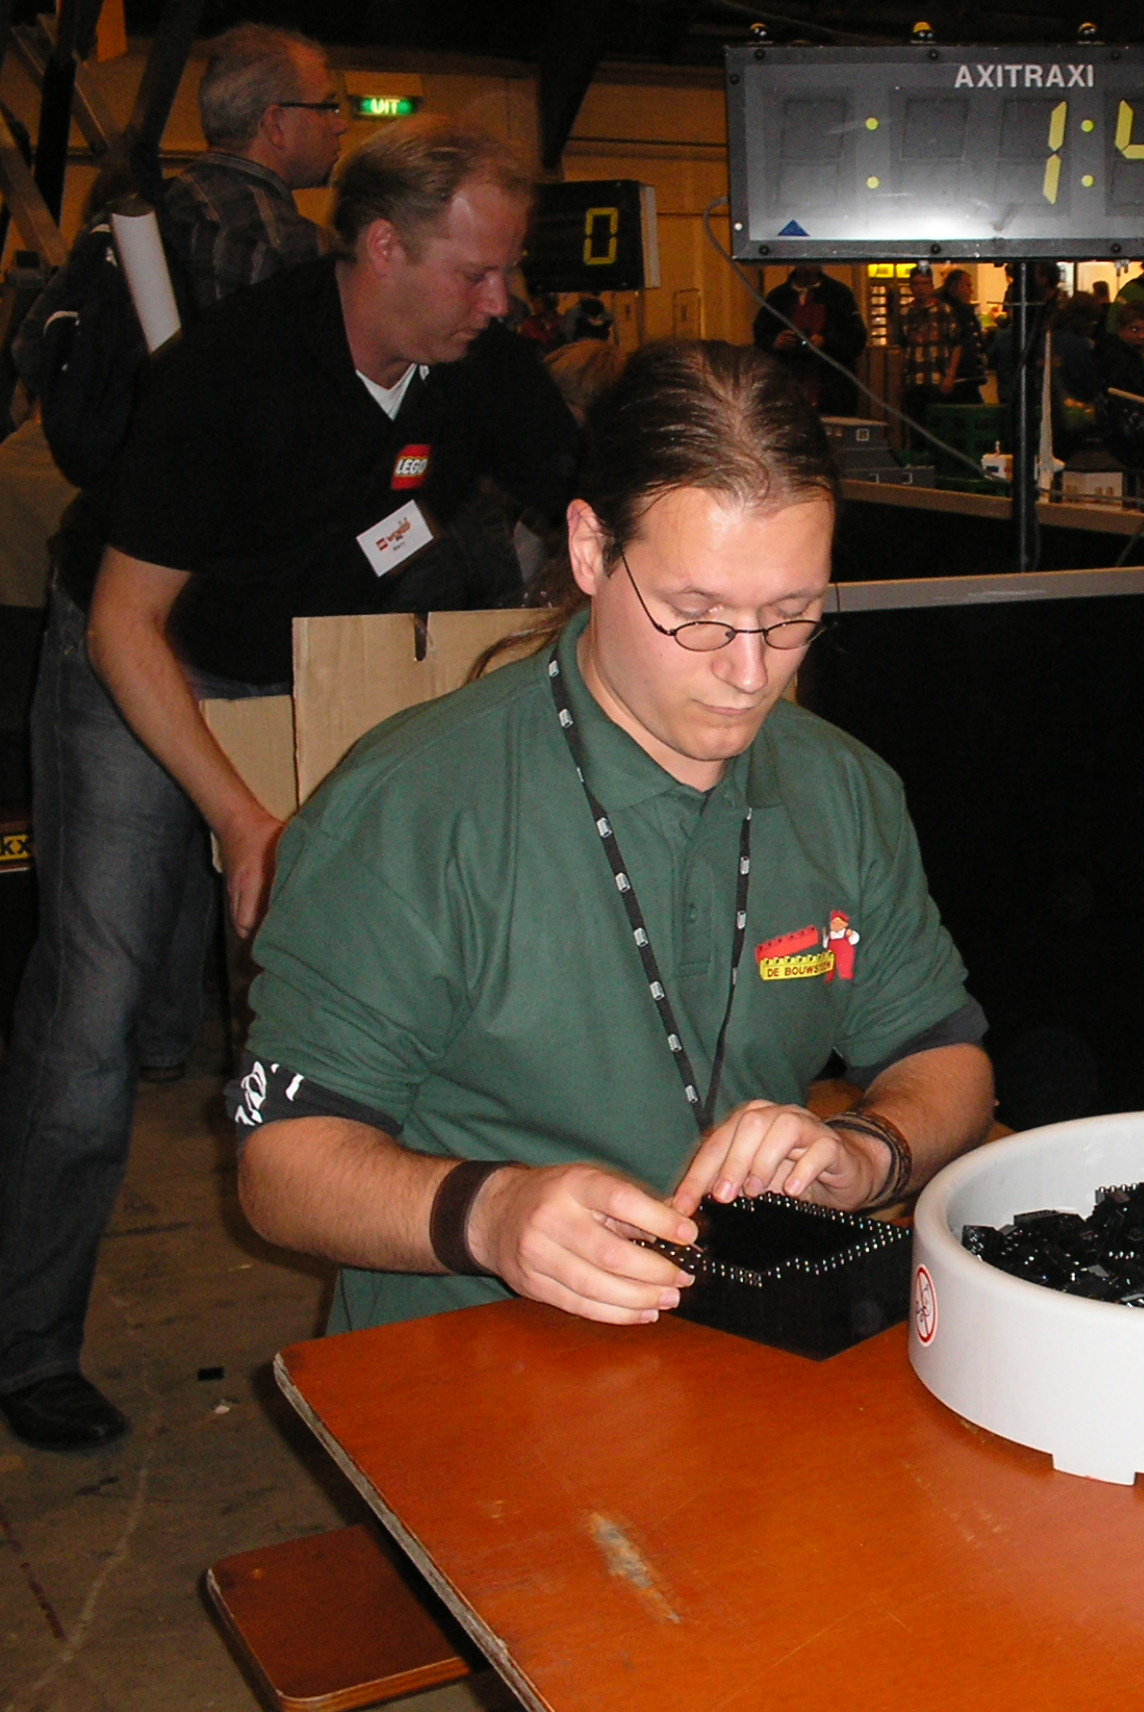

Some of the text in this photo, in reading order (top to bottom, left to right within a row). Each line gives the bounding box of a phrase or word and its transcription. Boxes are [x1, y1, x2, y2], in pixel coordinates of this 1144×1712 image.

[954, 63, 1095, 88] AXITRAXI
[370, 98, 400, 115] UIT
[395, 458, 428, 475] LEGO
[767, 967, 780, 978] DE
